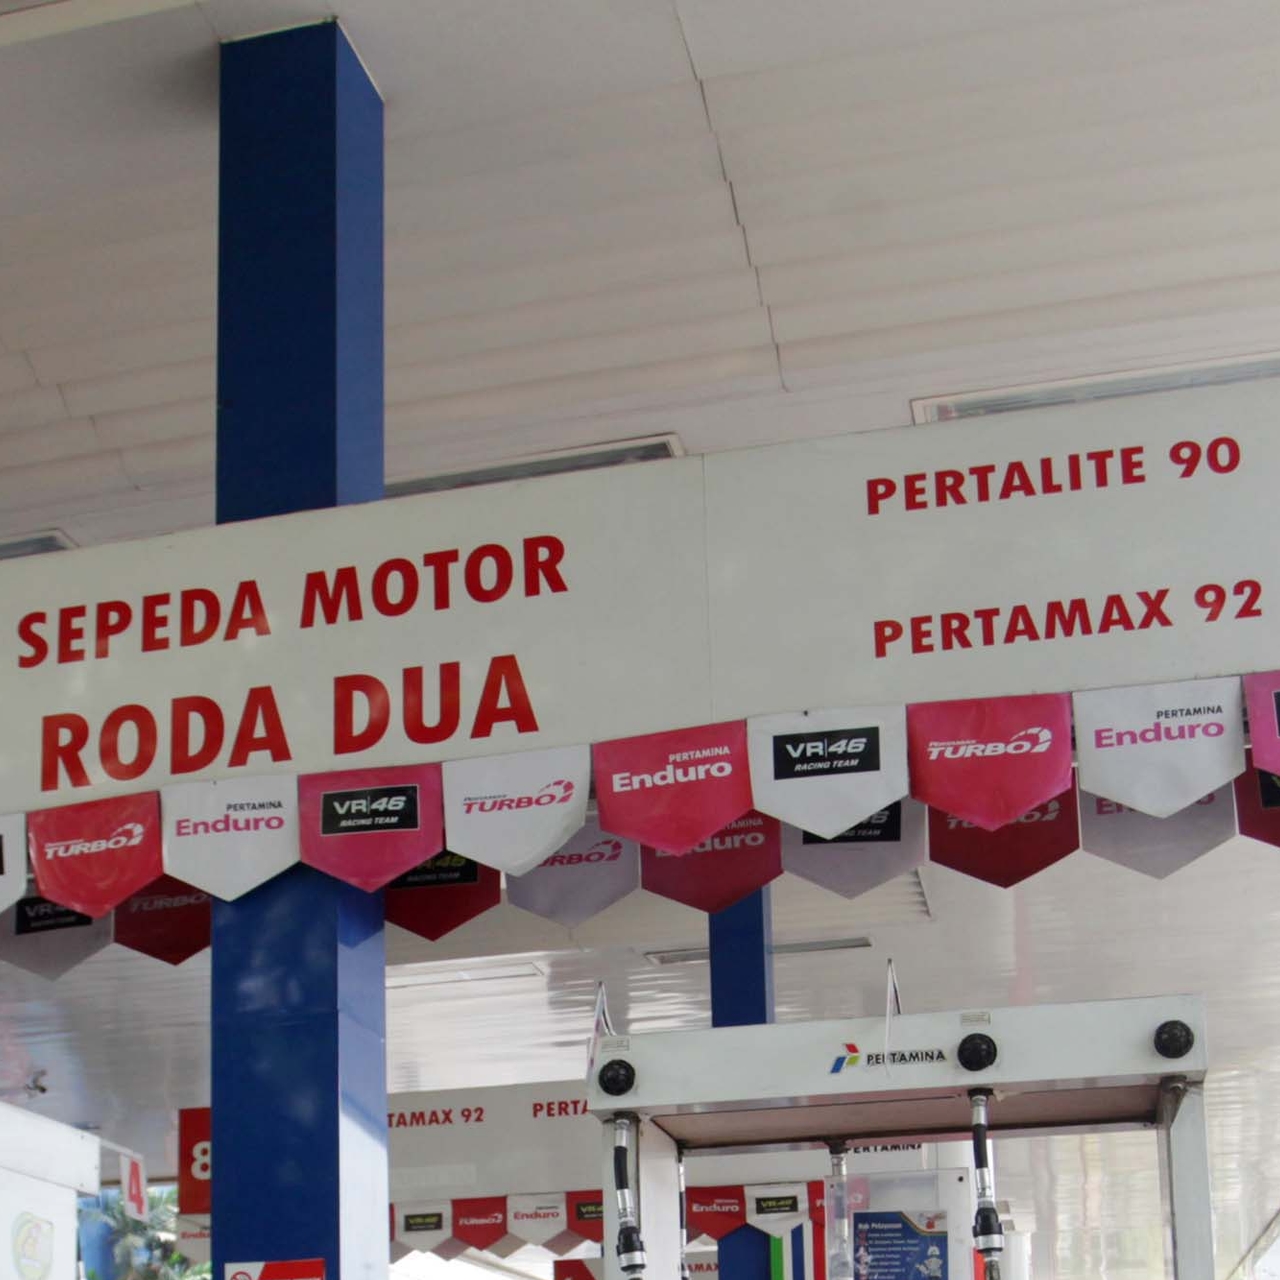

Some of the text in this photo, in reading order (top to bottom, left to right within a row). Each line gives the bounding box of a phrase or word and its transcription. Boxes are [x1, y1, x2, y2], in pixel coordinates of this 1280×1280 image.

[866, 436, 1242, 514] PERTALITE 90
[17, 535, 568, 668] SEPEDA MOTOR
[874, 580, 1263, 659] PERTAMAX 92
[40, 654, 539, 791] RODA DUA
[1157, 705, 1223, 719] PERTAMINA
[1094, 721, 1225, 748] Enduro
[669, 745, 730, 763] PERTAMINA
[794, 758, 859, 772] RACING TEAM
[612, 760, 732, 793] Enduro
[226, 800, 283, 812] PERTAMINA
[175, 814, 285, 837] Enduro
[339, 815, 399, 828] RACING TEAM
[461, 1107, 484, 1123] 92
[191, 1141, 211, 1180] 8
[128, 1159, 144, 1215] 4
[513, 1210, 559, 1220] Enduro
[692, 1203, 740, 1212] Enduro
